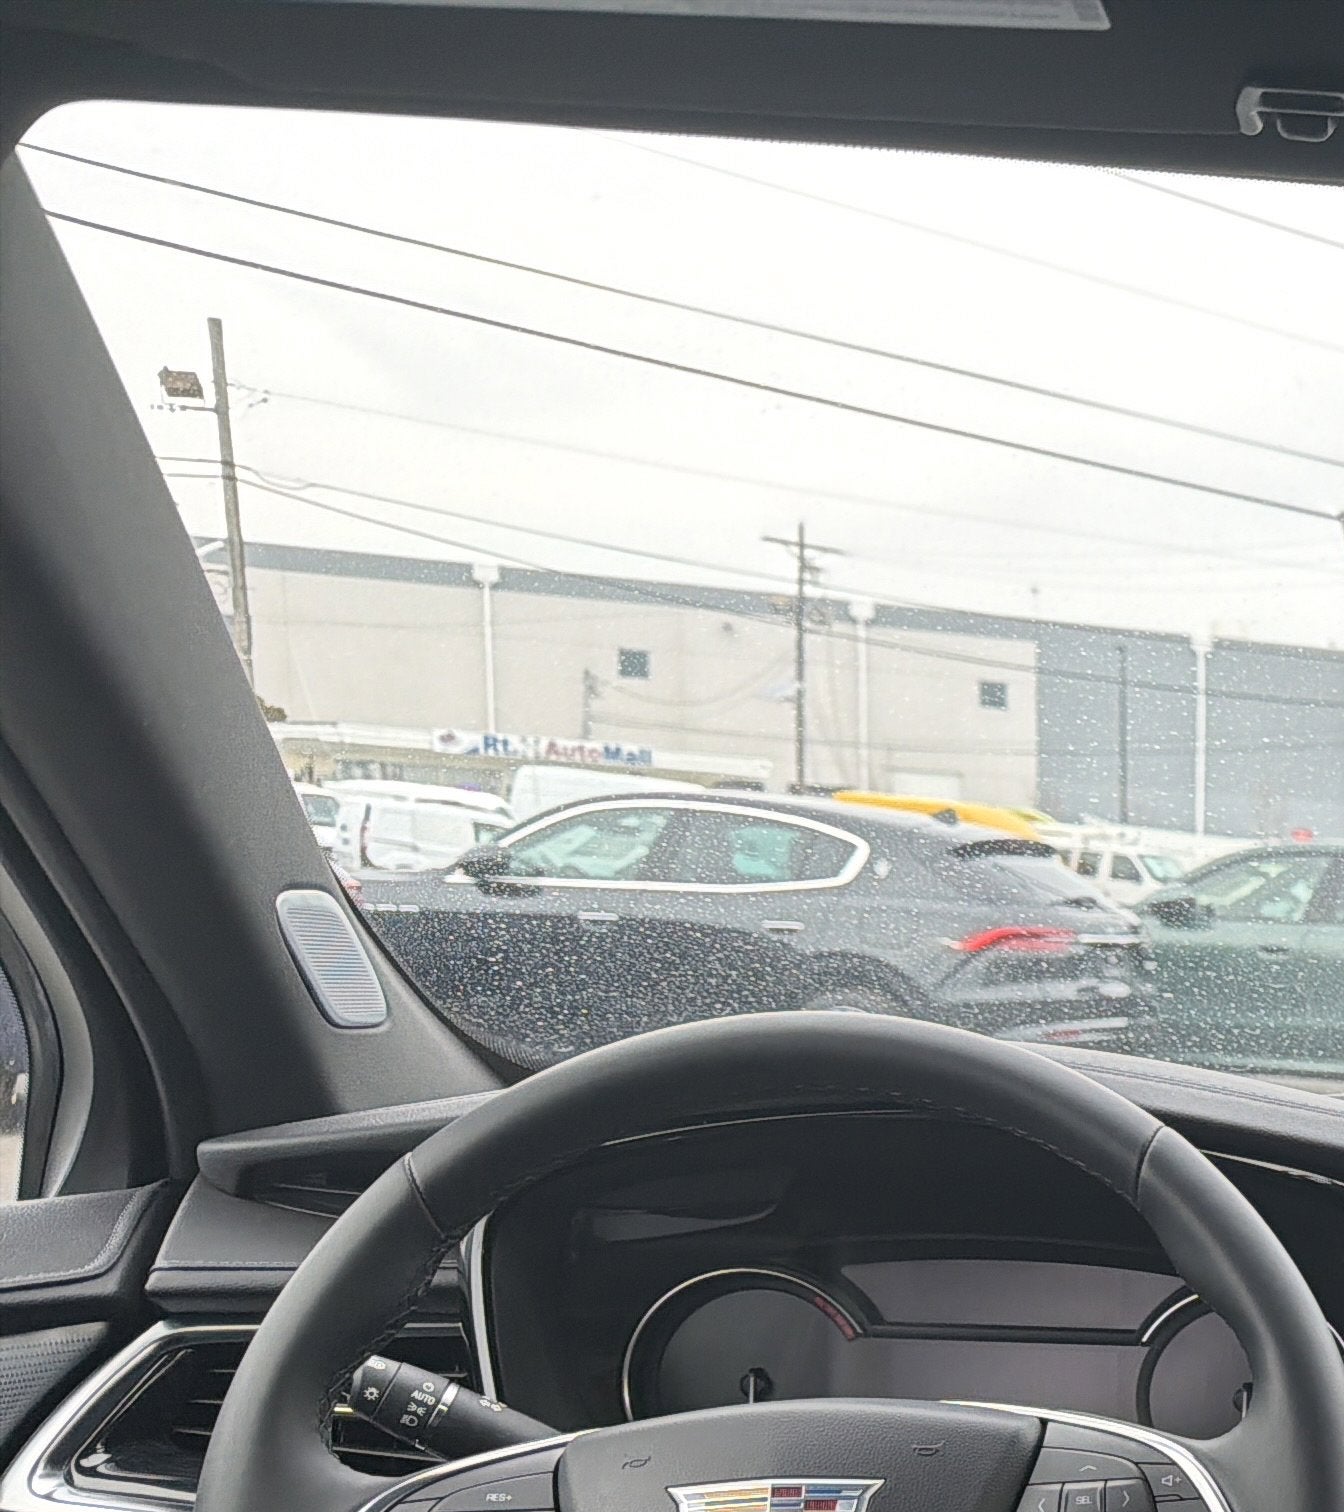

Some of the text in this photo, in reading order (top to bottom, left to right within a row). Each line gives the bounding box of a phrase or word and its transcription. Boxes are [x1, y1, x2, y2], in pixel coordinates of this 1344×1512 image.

[410, 1389, 436, 1406] AUTO
[486, 1492, 513, 1502] RES+
[1075, 1495, 1093, 1505] SEL
